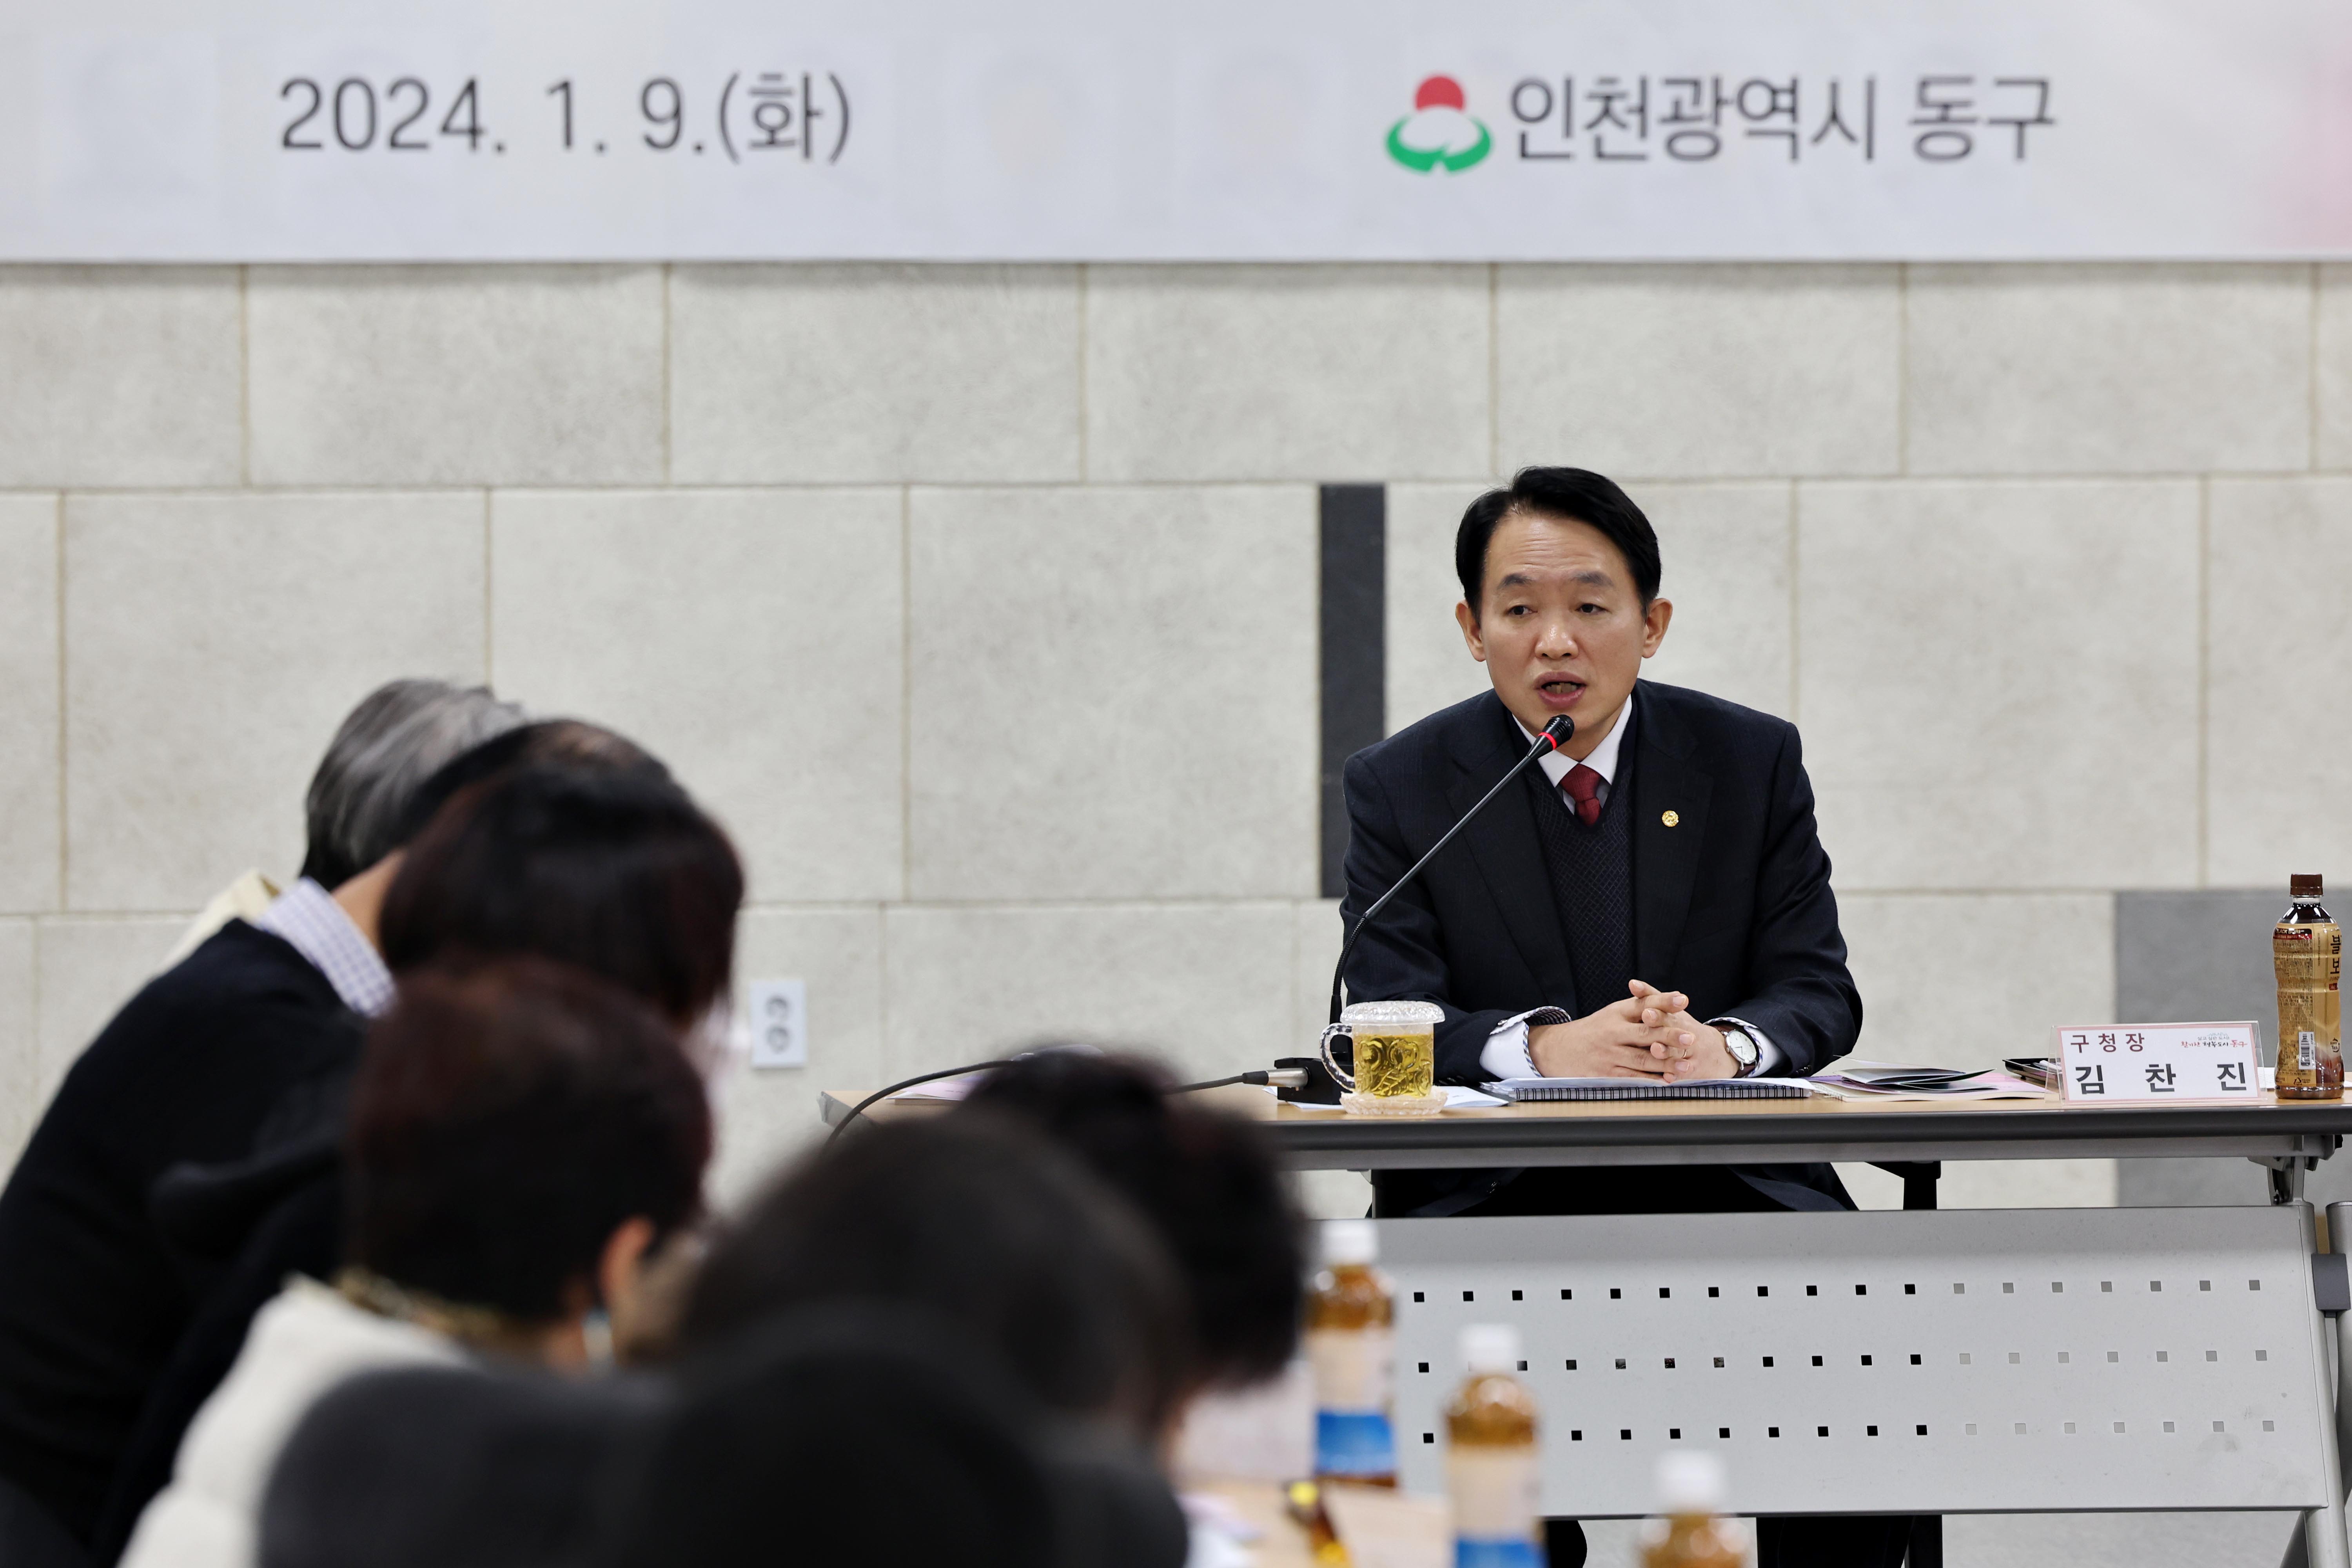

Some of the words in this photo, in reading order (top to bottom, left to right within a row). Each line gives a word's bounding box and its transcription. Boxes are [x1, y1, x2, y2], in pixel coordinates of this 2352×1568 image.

[280, 76, 506, 154] 2024.
[546, 78, 607, 154] 1.
[639, 72, 852, 165] 9.(화)
[1509, 74, 1875, 162] 인천광역시
[1908, 75, 2056, 163] 동구
